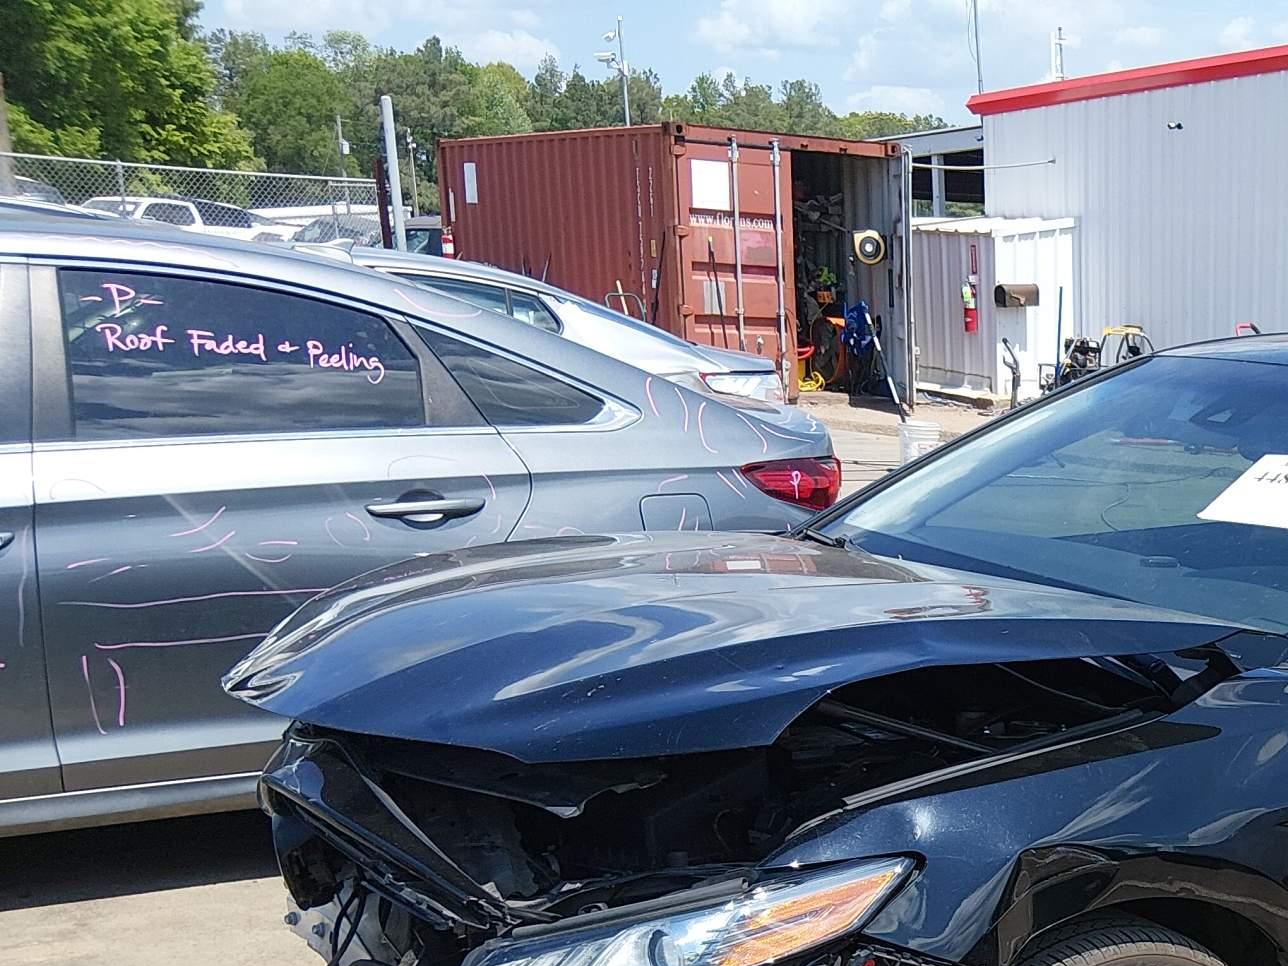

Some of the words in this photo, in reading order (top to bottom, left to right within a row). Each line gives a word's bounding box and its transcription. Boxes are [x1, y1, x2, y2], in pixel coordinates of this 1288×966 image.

[689, 212, 774, 229] www.florns.com
[95, 323, 176, 352] Roof
[187, 330, 267, 361] Faded
[306, 340, 385, 384] Peeling
